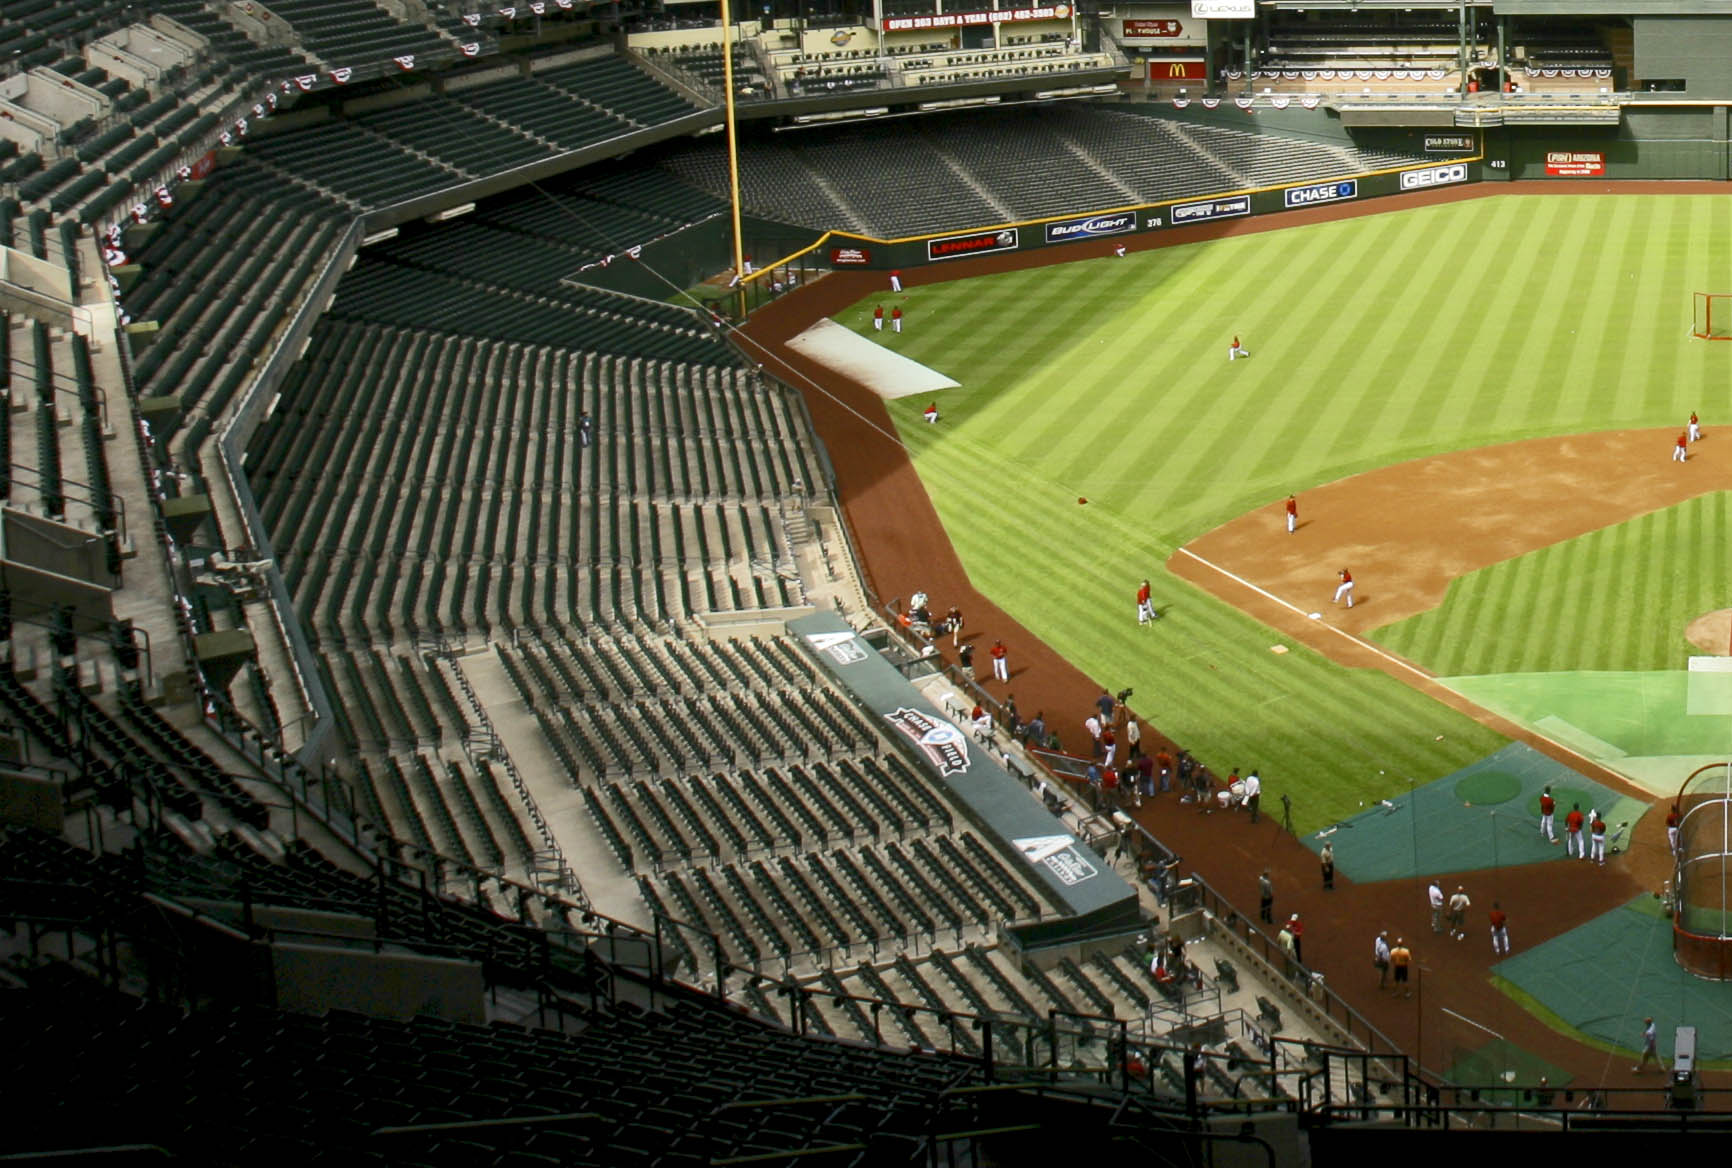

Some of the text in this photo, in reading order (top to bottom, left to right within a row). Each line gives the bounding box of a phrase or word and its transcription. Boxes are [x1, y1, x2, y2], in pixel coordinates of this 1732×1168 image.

[1490, 160, 1506, 168] 413
[1403, 165, 1466, 188] GEICO
[1291, 186, 1338, 203] CHASE
[1051, 217, 1128, 236] BUD LIGHT
[932, 236, 996, 255] LENNAR
[903, 712, 933, 732] CHASE
[941, 743, 963, 766] FIELD
